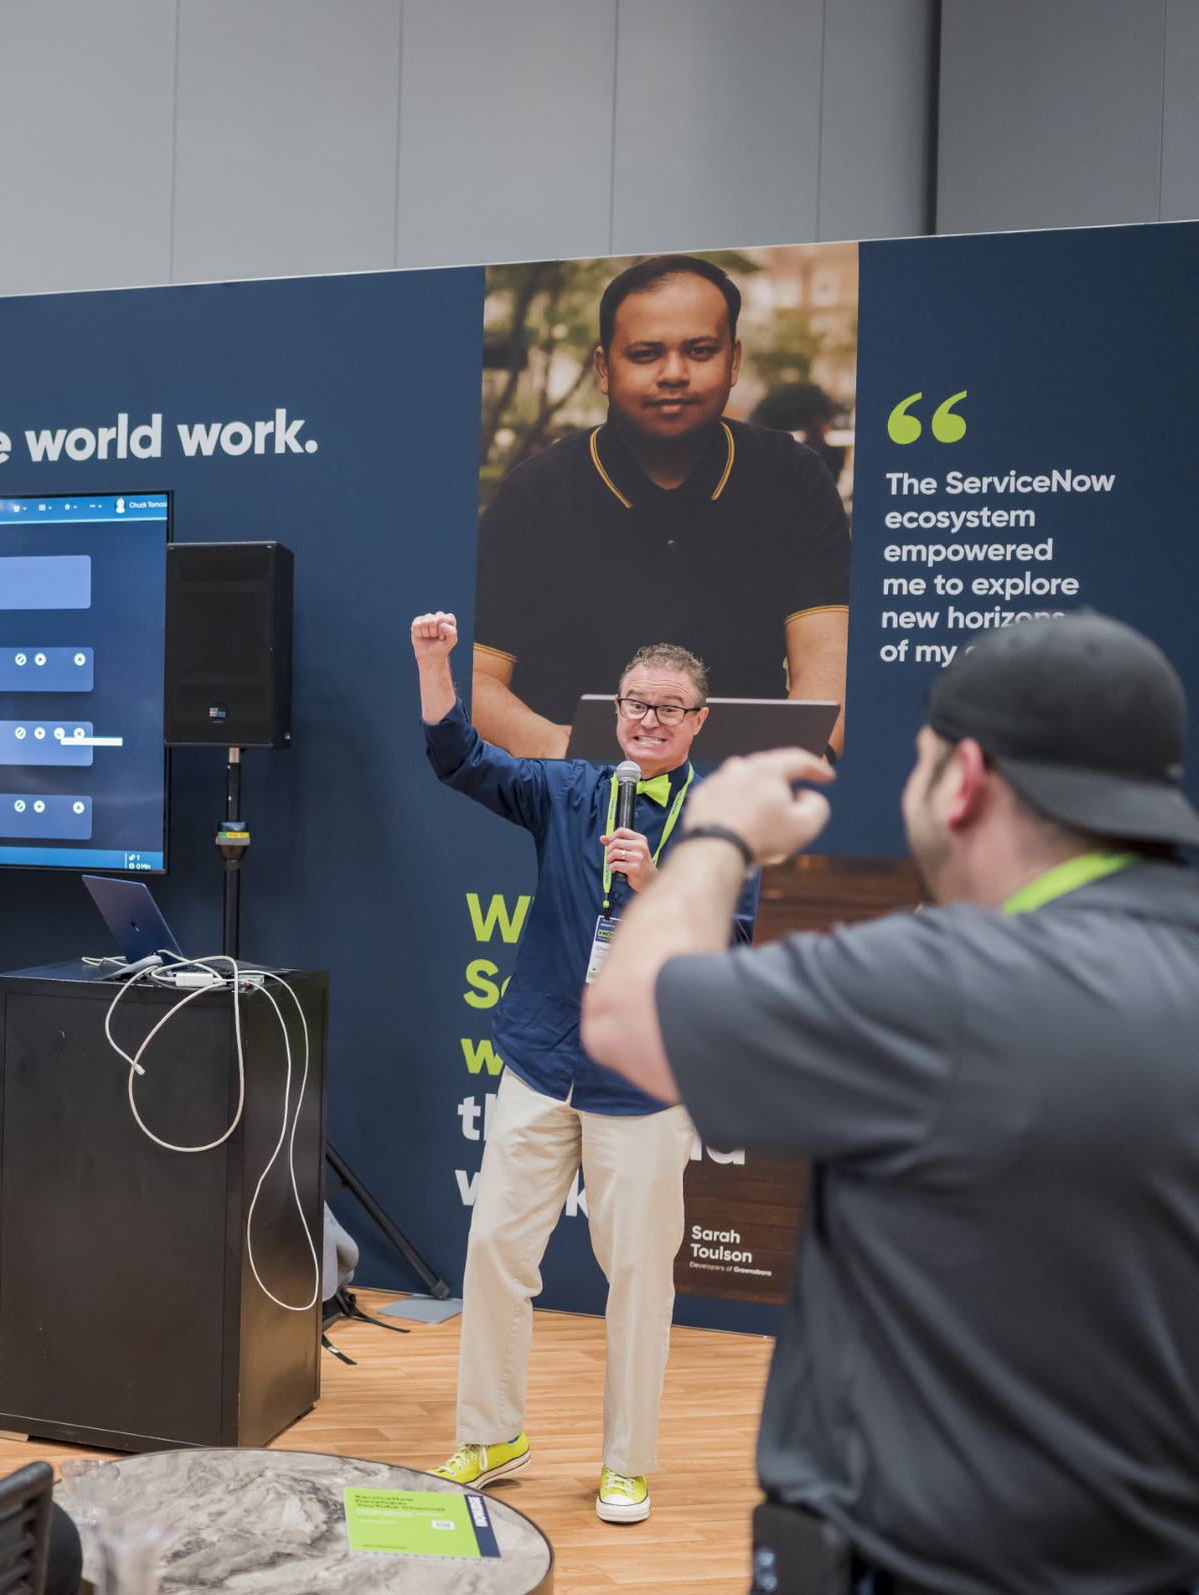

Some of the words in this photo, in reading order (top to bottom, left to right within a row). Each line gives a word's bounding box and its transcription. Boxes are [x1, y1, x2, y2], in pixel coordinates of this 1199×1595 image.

[25, 413, 162, 462] world
[177, 408, 318, 457] work.
[886, 472, 937, 495] The
[945, 469, 1116, 494] ServiceNow
[885, 506, 1035, 533] ecosystem
[884, 538, 1053, 567] empowered
[883, 577, 926, 595] me
[934, 574, 964, 595] to
[971, 571, 1079, 600] explore
[881, 611, 939, 629] new
[880, 639, 909, 662] of
[915, 644, 957, 668] my
[691, 1225, 740, 1244] Sarah
[689, 1261, 725, 1271] Developers
[690, 1243, 752, 1263] Toulson
